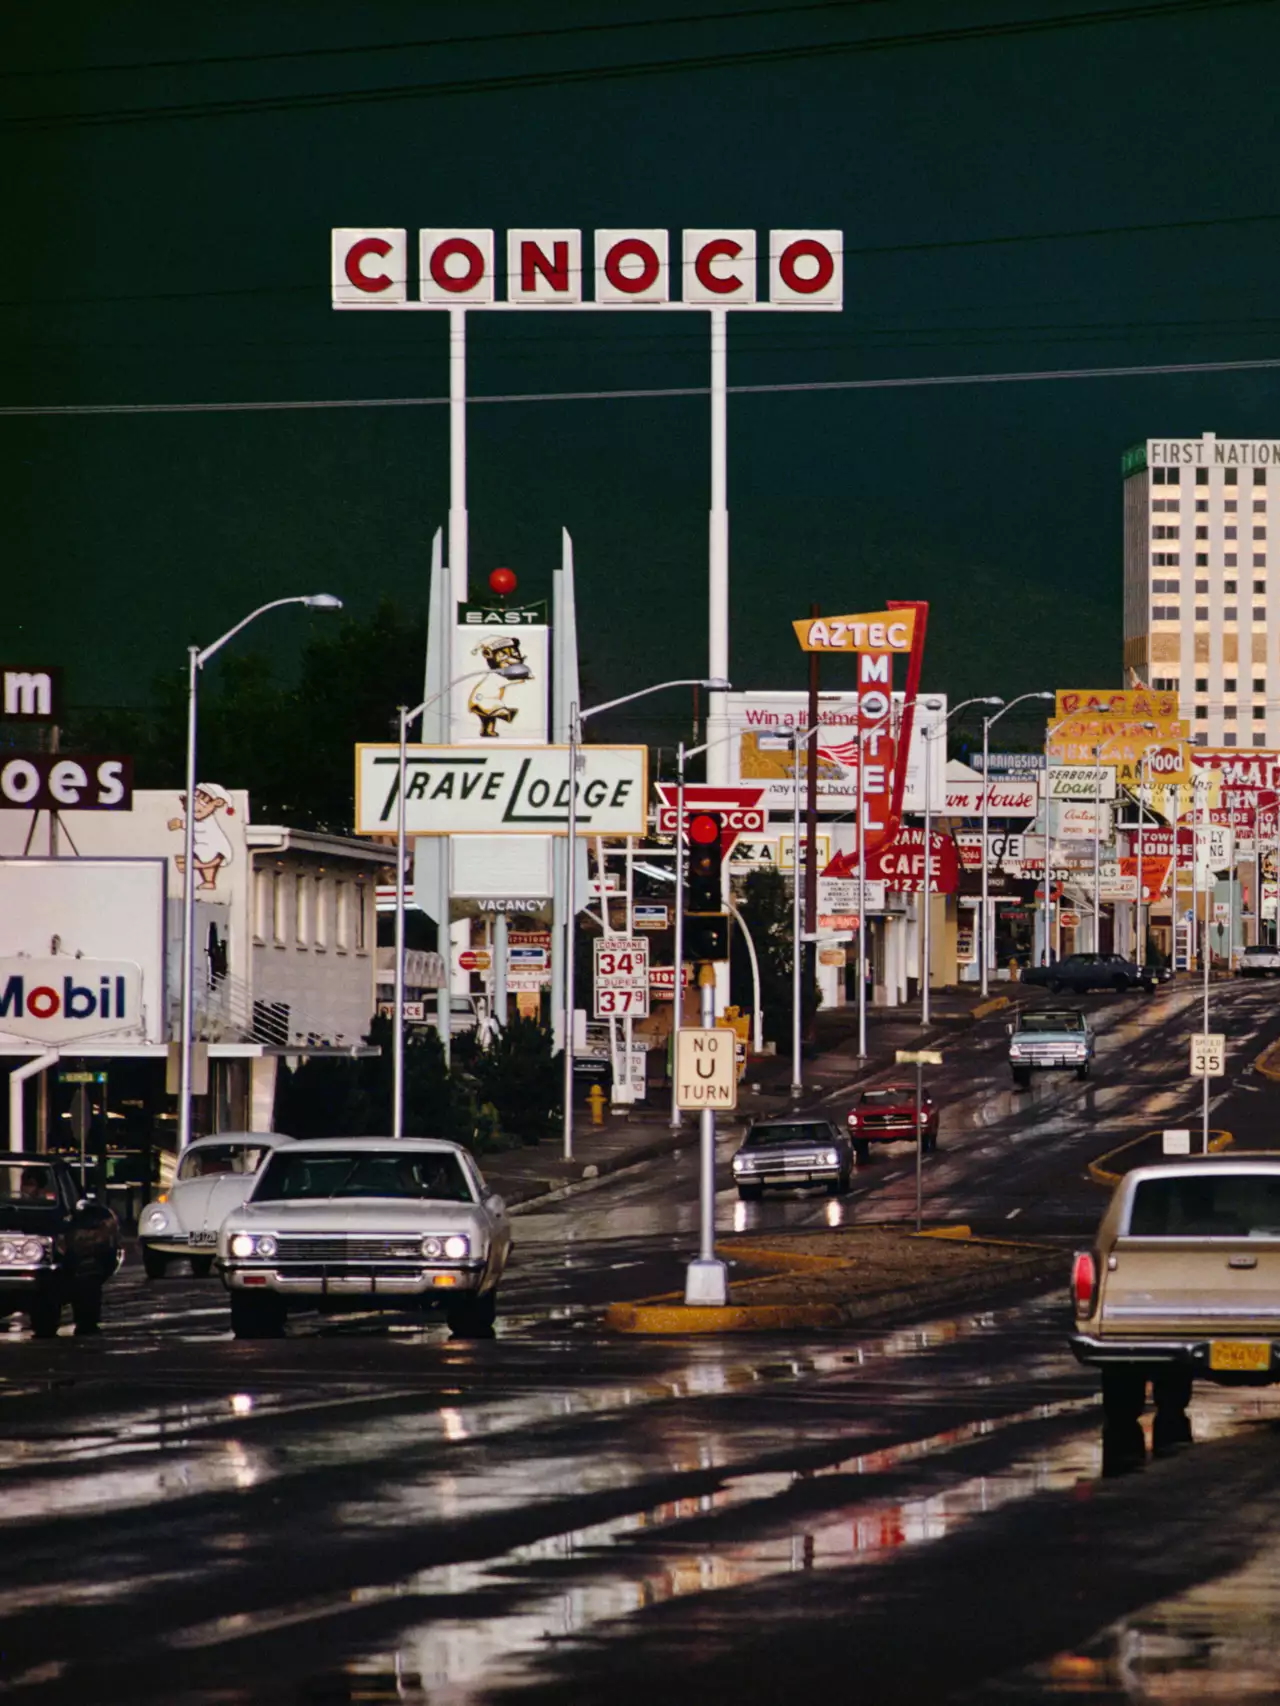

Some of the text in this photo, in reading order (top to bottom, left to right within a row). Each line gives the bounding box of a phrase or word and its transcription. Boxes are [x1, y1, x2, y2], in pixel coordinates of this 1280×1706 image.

[345, 237, 834, 294] CONOCO
[1151, 443, 1204, 463] FIRST
[465, 611, 539, 624] EAST
[808, 621, 908, 648] AZTEC
[746, 710, 858, 725] Win a lietime
[861, 654, 890, 830] MOTEL
[1050, 743, 1135, 760] MEXCAN
[1186, 812, 1248, 822] RODSIDE
[880, 853, 941, 876] CAFE
[881, 878, 939, 892] PIZZA
[477, 900, 547, 912] VACANCY
[599, 941, 643, 949] CONOTANE
[604, 978, 639, 987] SUPER
[0, 975, 125, 1019] Mobil
[694, 1038, 718, 1052] NO
[696, 1059, 715, 1079] U
[1195, 1055, 1220, 1071] 35
[682, 1085, 730, 1099] TURN
